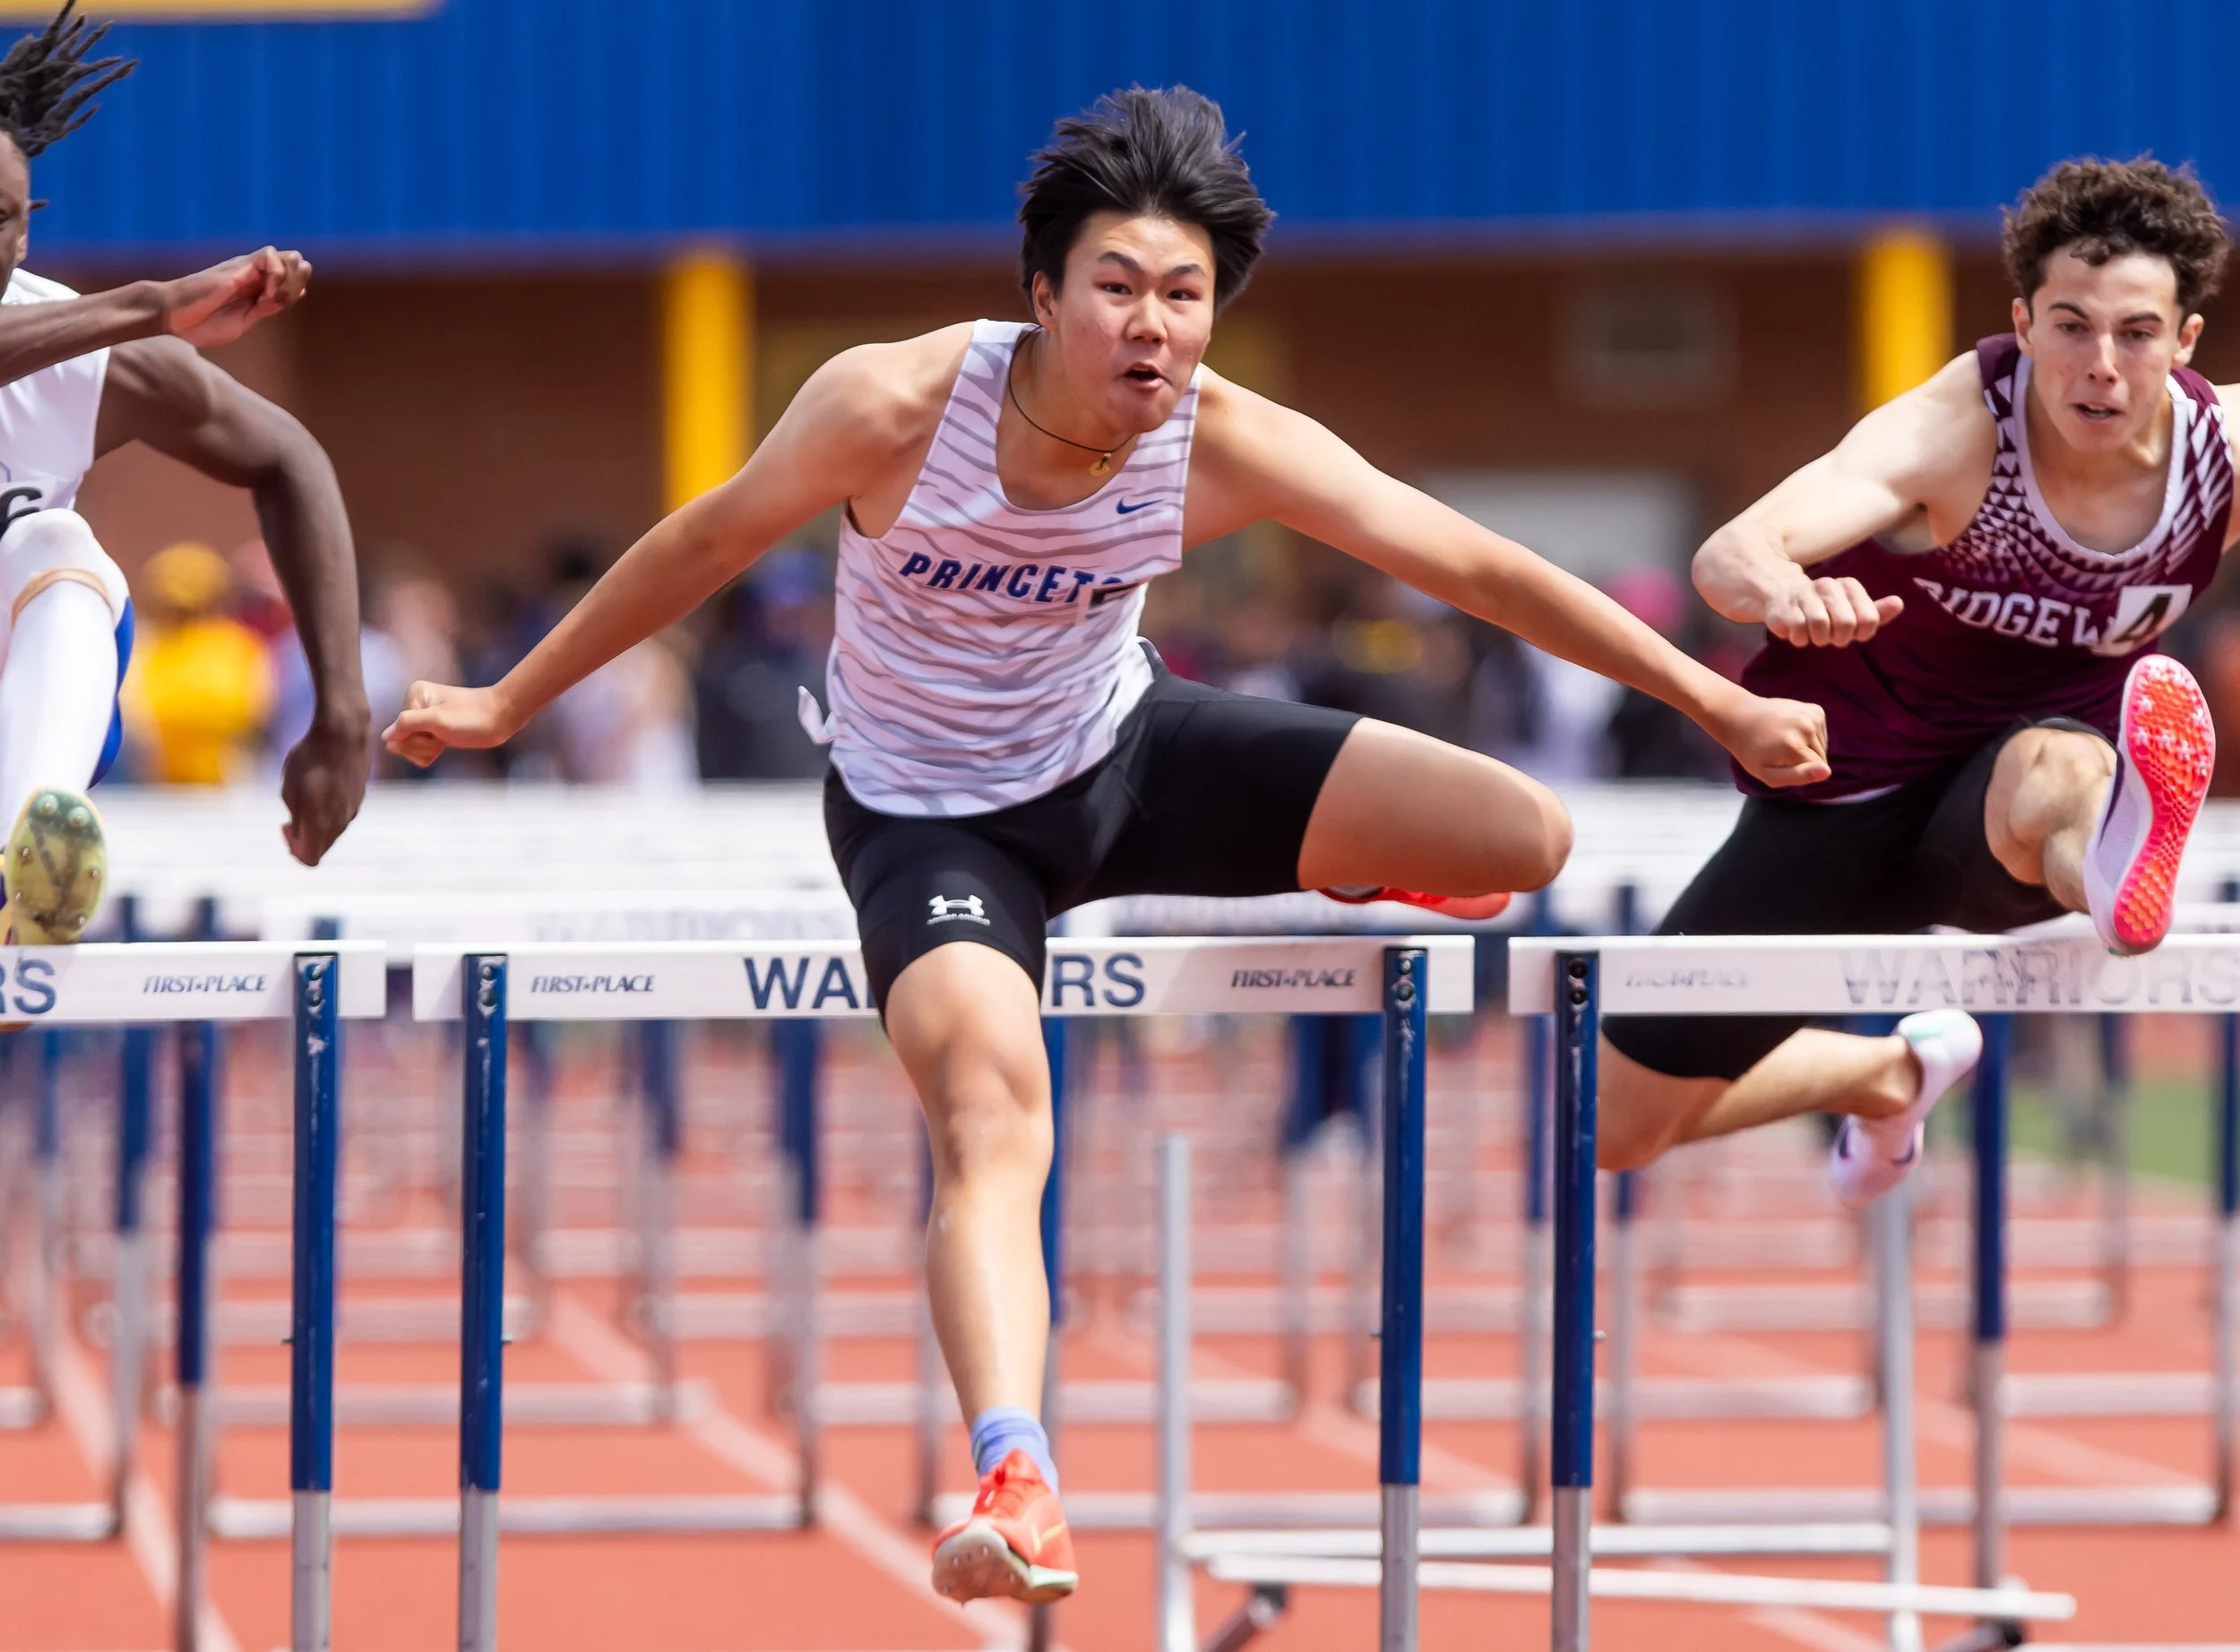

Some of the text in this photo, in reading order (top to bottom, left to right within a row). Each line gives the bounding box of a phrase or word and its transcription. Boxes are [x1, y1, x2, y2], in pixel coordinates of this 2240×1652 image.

[898, 551, 1125, 604] PRINCET
[203, 973, 267, 993] PLACE
[591, 974, 655, 993] PLACE
[1290, 968, 1357, 987] PLACE
[1837, 946, 2240, 1005] WARRIORS
